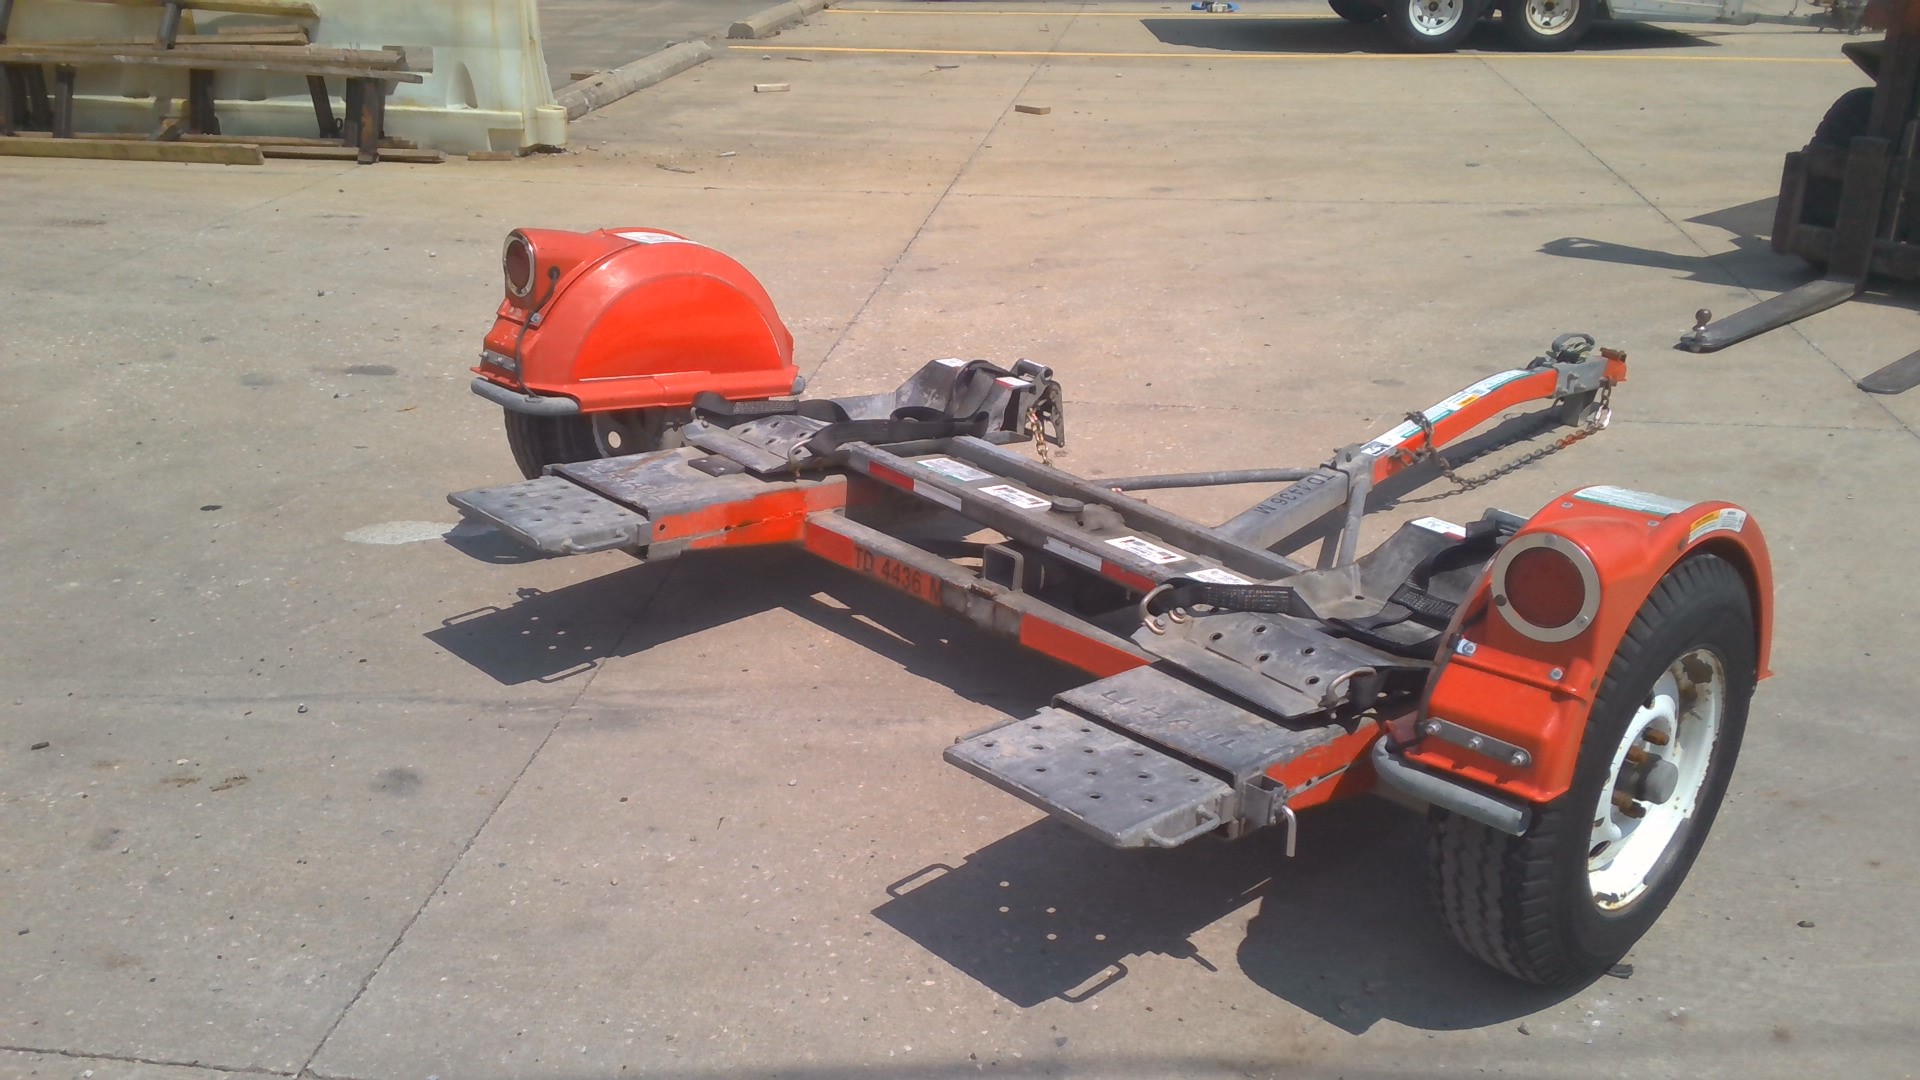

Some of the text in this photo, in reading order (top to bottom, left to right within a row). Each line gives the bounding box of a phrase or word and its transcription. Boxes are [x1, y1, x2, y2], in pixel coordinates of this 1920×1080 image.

[1253, 503, 1277, 515] M
[855, 546, 874, 572] TD
[882, 559, 922, 593] 4436
